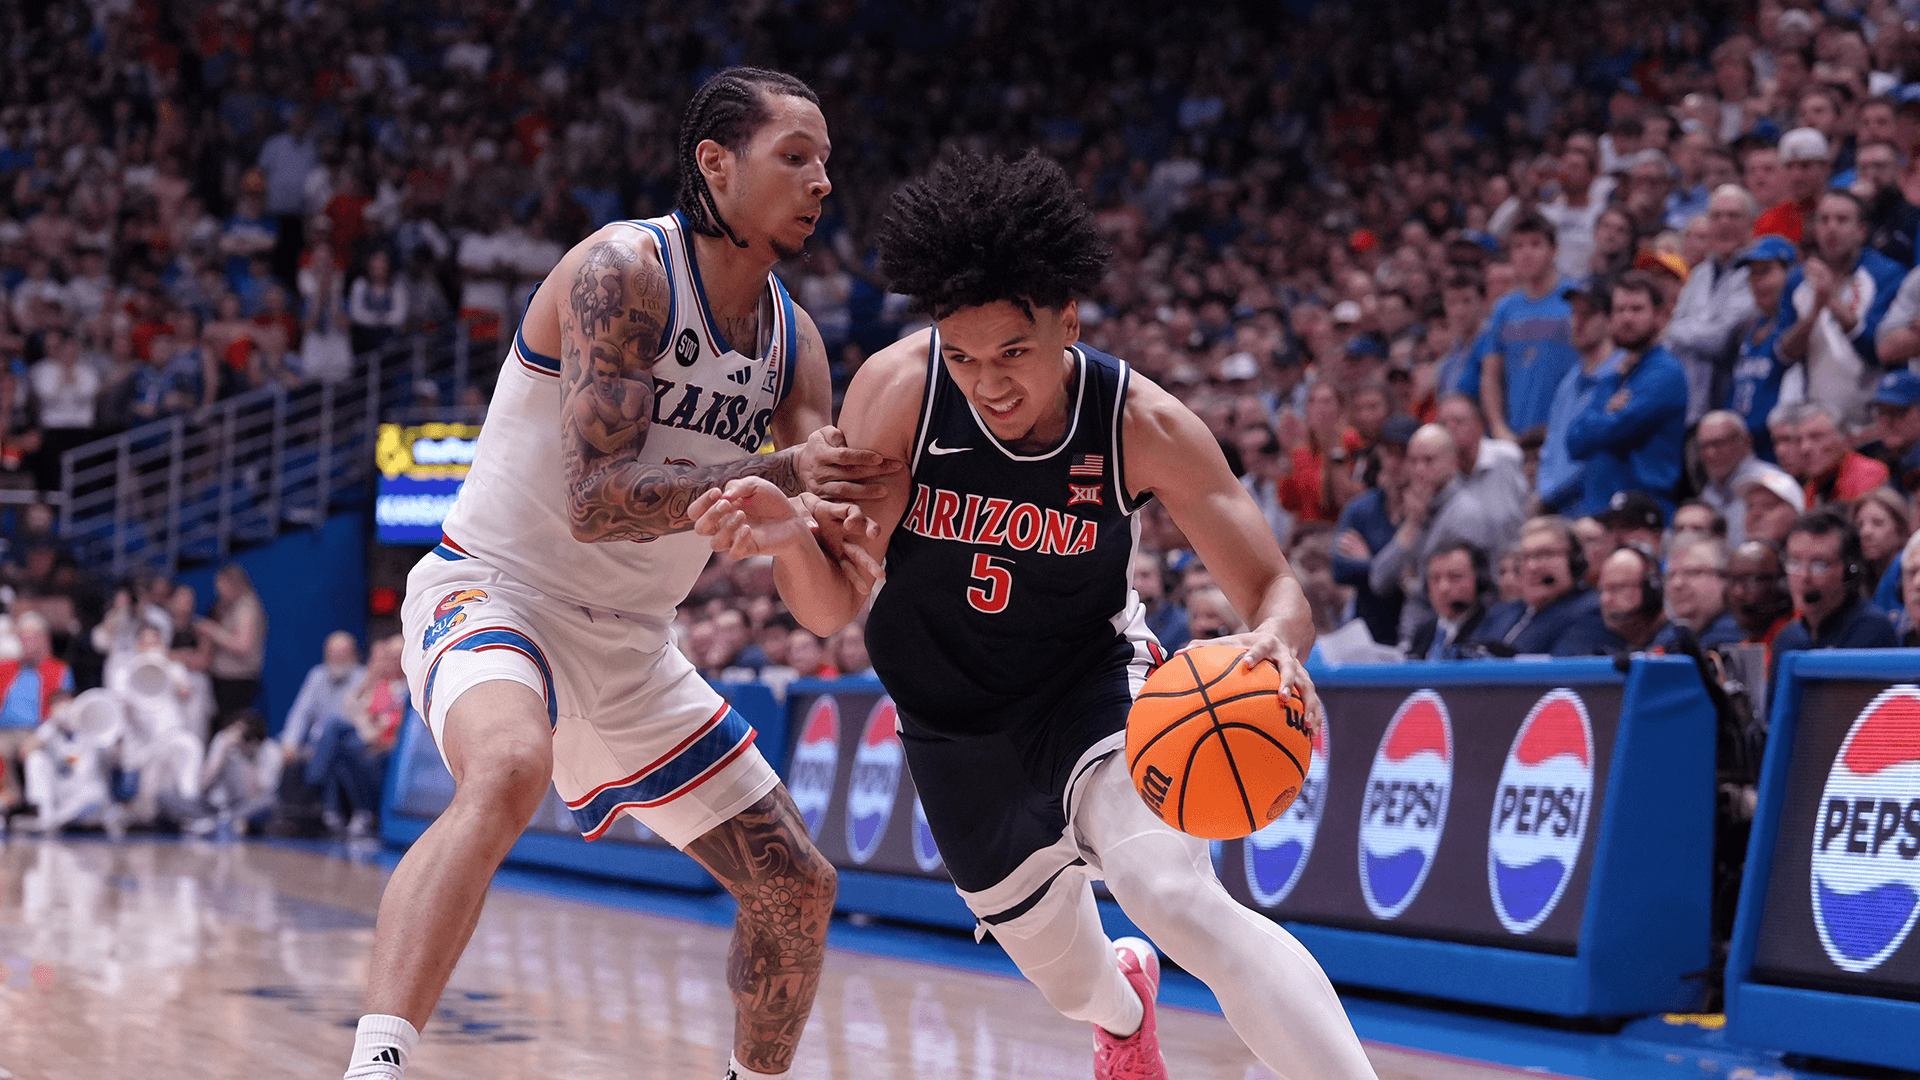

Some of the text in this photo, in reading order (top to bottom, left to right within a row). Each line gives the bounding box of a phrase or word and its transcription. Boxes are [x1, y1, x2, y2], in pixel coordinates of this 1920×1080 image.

[902, 483, 1098, 556] ARIZONA
[1069, 485, 1102, 504] XII
[966, 553, 1016, 614] 5
[1368, 780, 1444, 827] PEPSI
[1500, 785, 1585, 838] PEPSI
[1821, 799, 1920, 860] PEPS
